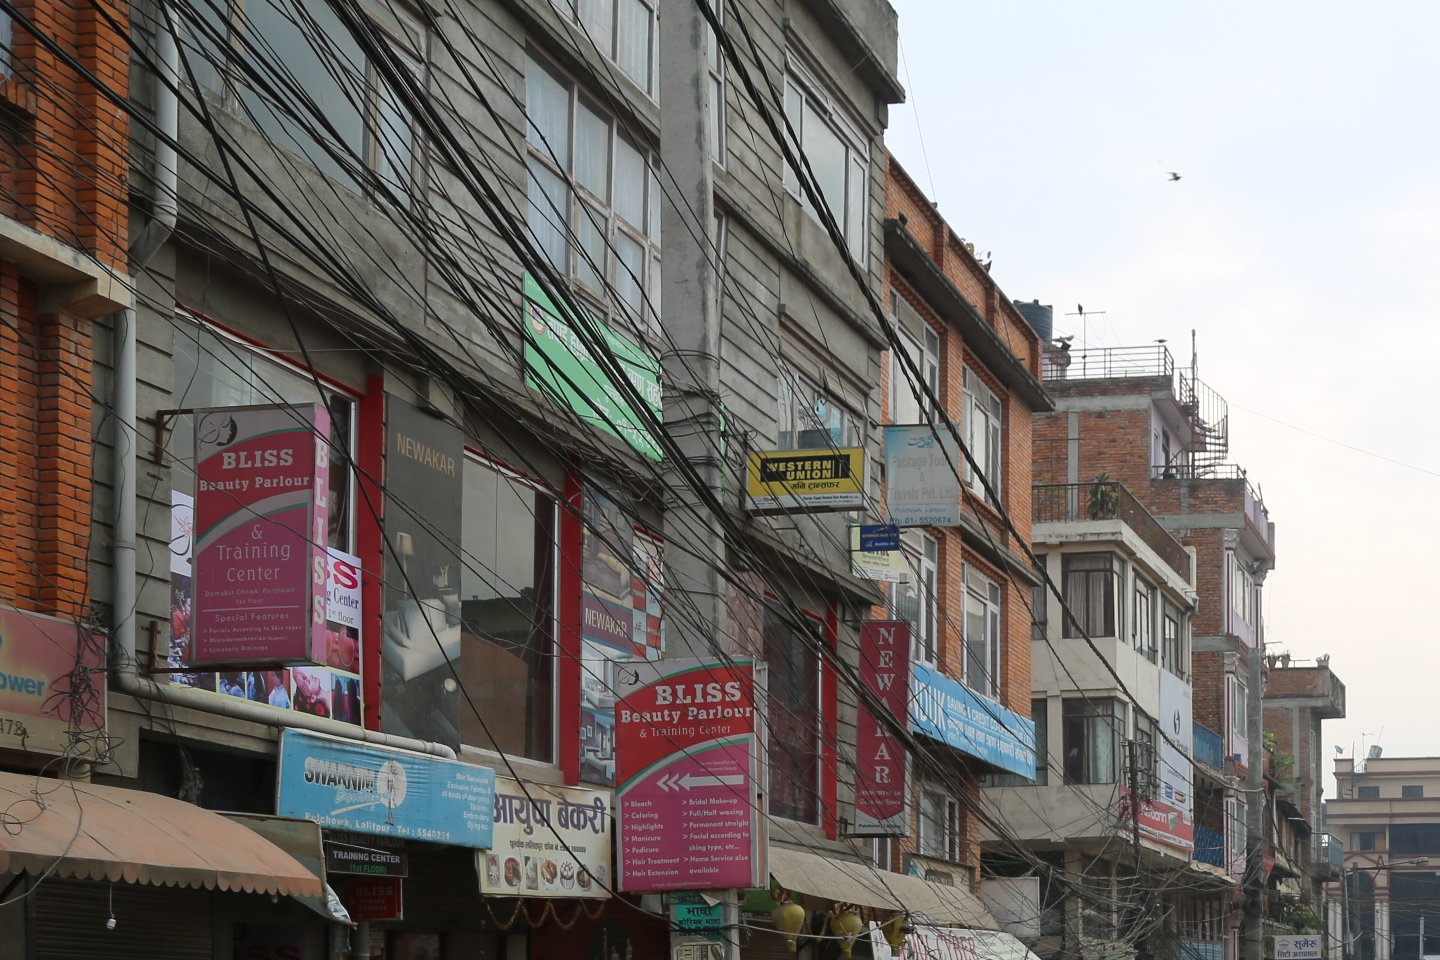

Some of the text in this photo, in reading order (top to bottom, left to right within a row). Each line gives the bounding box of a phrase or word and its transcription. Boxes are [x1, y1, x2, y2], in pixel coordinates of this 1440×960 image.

[222, 448, 293, 470] BLISS
[397, 433, 455, 478] NEWAKAR
[766, 460, 832, 472] WESTERN
[891, 454, 927, 470] Package
[786, 469, 831, 480] UNION
[919, 472, 925, 482] &
[199, 475, 310, 492] Beauty Parlour
[888, 486, 956, 500] Travels Pvt. Ltd.
[925, 506, 947, 514] Lalitpur
[919, 516, 952, 524] 5520674
[251, 524, 263, 539] &
[314, 437, 328, 625] BLISS
[216, 542, 291, 561] Training
[227, 565, 280, 582] Center
[262, 587, 295, 595] Pulchowk
[333, 589, 359, 610] Center
[215, 611, 289, 623] Special Features
[337, 610, 354, 625] floor
[584, 607, 628, 638] NEWAKAR
[232, 626, 262, 634] According
[285, 625, 302, 633] types
[655, 681, 742, 705] BLISS
[620, 705, 753, 724] Beauty Parlour
[971, 709, 989, 727] CREDIT
[639, 724, 731, 738] & Training Center
[304, 757, 376, 793] SWARNIM
[456, 772, 489, 784] Our Services
[447, 781, 470, 792] Exclusive
[470, 784, 487, 794] Fabrics
[448, 790, 461, 800] kinds
[461, 792, 468, 800] of
[689, 797, 738, 806] Bridal Make-up
[557, 791, 606, 834] बेकरी
[631, 811, 659, 820] Coloring
[689, 809, 744, 817] Full/Half waxing
[305, 811, 353, 829] Pulchowk,
[355, 819, 390, 834] Lalitpur
[417, 828, 450, 841] 5540251
[467, 820, 481, 831] Dying
[631, 823, 664, 832] Highlights
[689, 819, 749, 828] Permanent straight
[631, 834, 661, 842] Manicure
[712, 831, 741, 840] according
[689, 844, 706, 852] sking
[707, 843, 724, 852] type,
[332, 850, 400, 864] TRAINING CENTER
[648, 856, 680, 865] Treatment
[710, 854, 733, 862] Service
[349, 863, 387, 874] (1st FLOOR)
[647, 869, 679, 877] Extension
[689, 866, 719, 874] available
[356, 886, 393, 897] BLISS
[686, 905, 713, 917] भाषा
